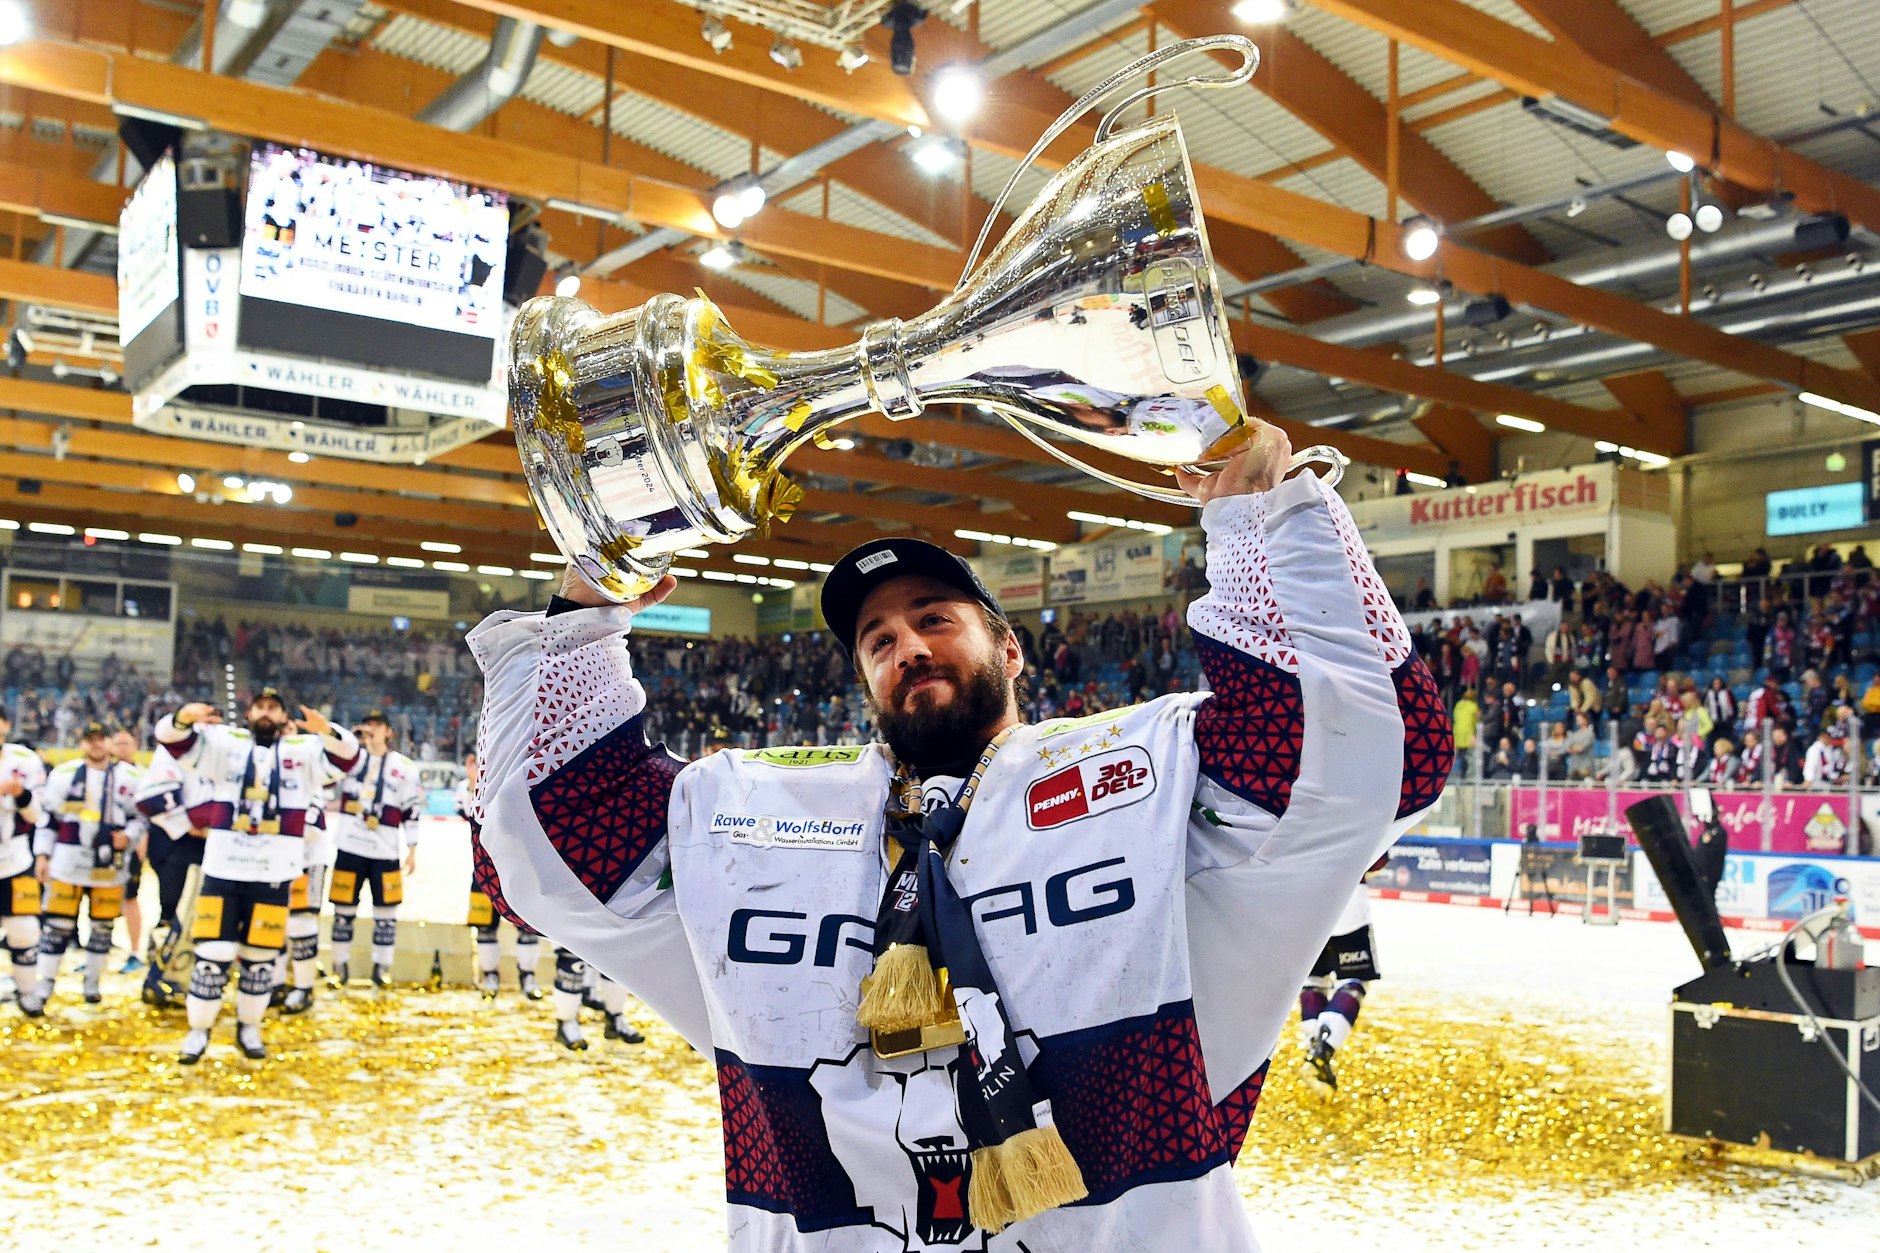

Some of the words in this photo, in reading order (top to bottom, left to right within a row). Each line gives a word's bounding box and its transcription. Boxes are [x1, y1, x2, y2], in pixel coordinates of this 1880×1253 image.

[1410, 474, 1597, 525] Kutterfisch
[1098, 760, 1132, 783] 30
[714, 813, 756, 828] Rawe
[776, 820, 864, 836] Wolfsdorff
[836, 838, 858, 846] GmbH
